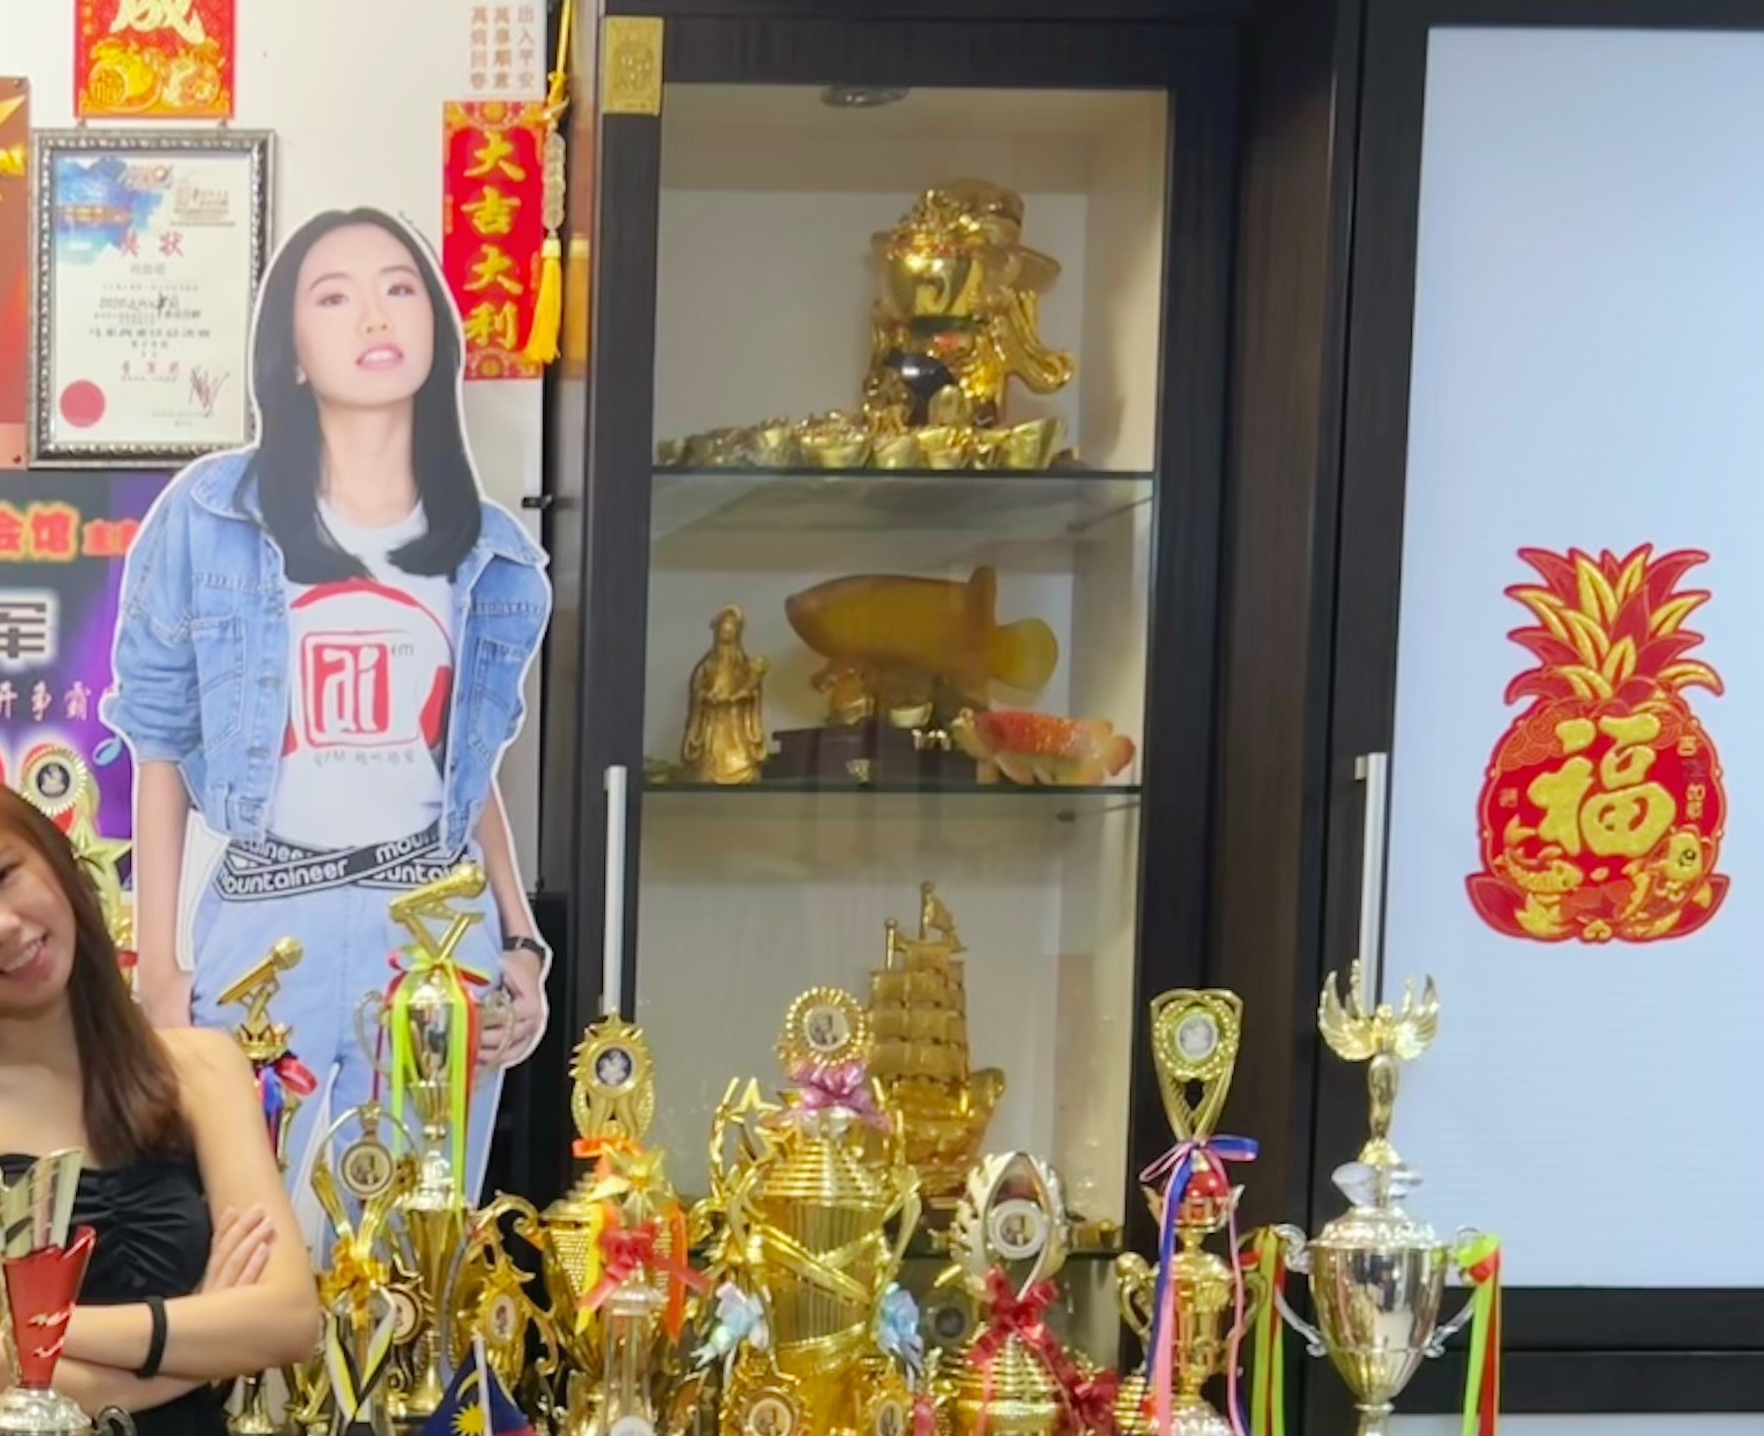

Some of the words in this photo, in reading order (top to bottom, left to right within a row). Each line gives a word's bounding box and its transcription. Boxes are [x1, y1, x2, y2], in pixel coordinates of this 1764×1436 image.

[460, 131, 527, 349] 大吉大利
[1527, 713, 1677, 857] 福
